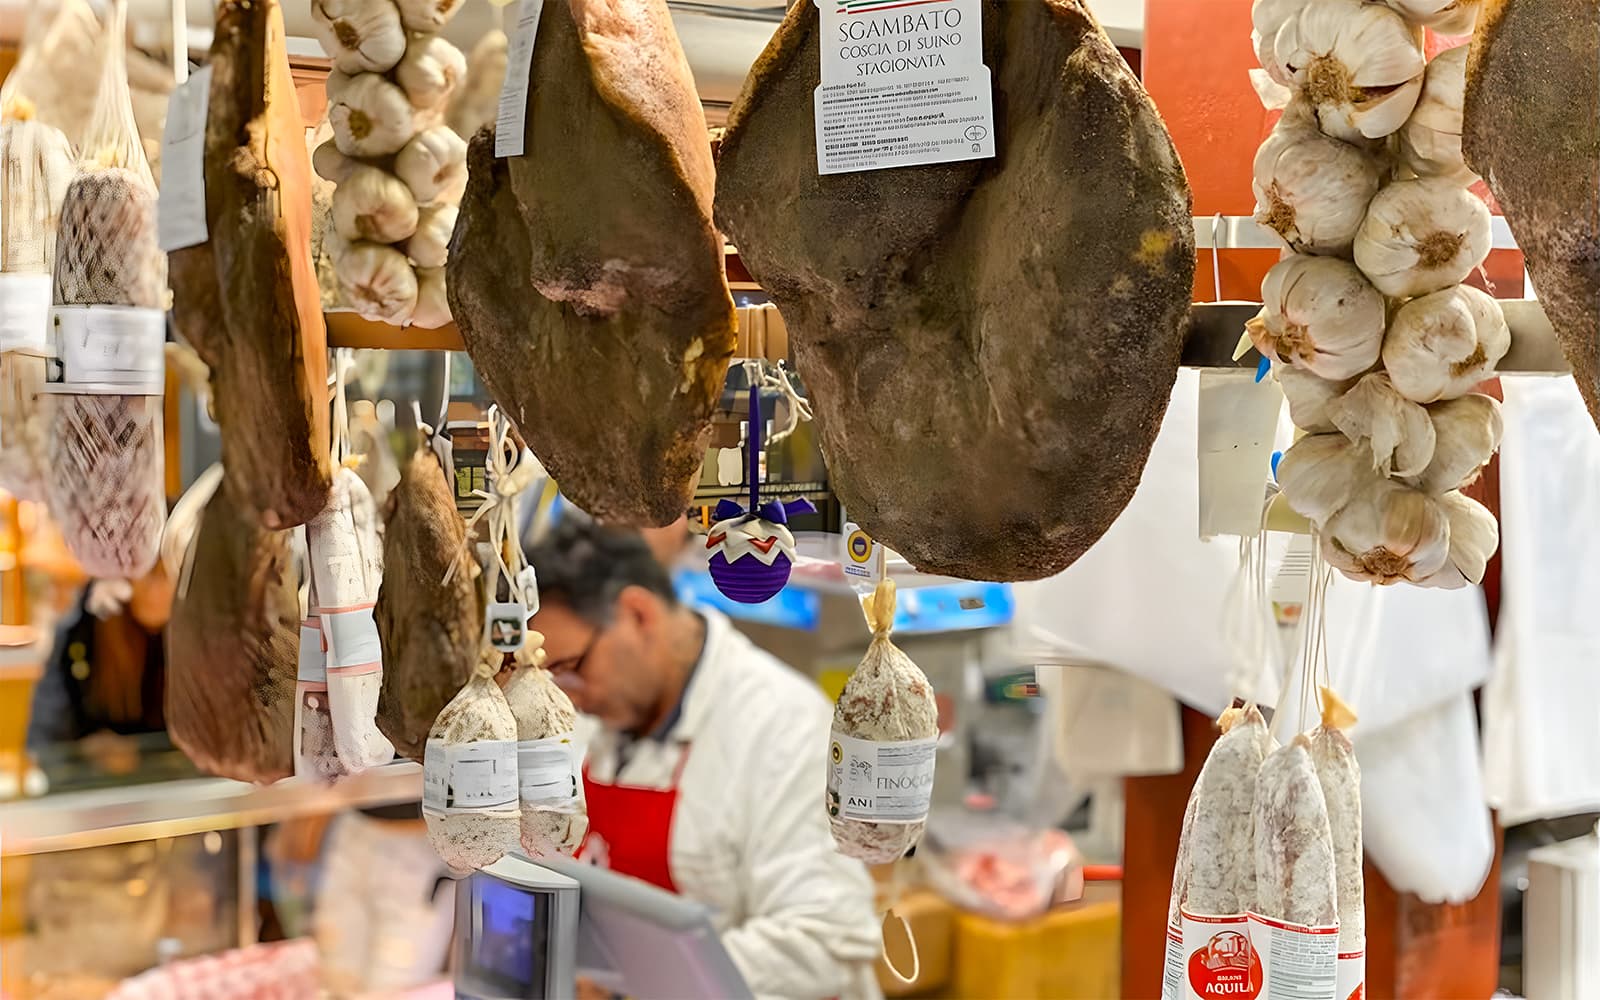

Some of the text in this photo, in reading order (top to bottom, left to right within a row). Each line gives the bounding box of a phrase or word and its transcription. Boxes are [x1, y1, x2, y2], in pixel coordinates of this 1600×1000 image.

[839, 8, 962, 42] SGAMBATO
[839, 32, 962, 60] COSCIA DI SUINO
[1205, 982, 1255, 995] AQUILA
